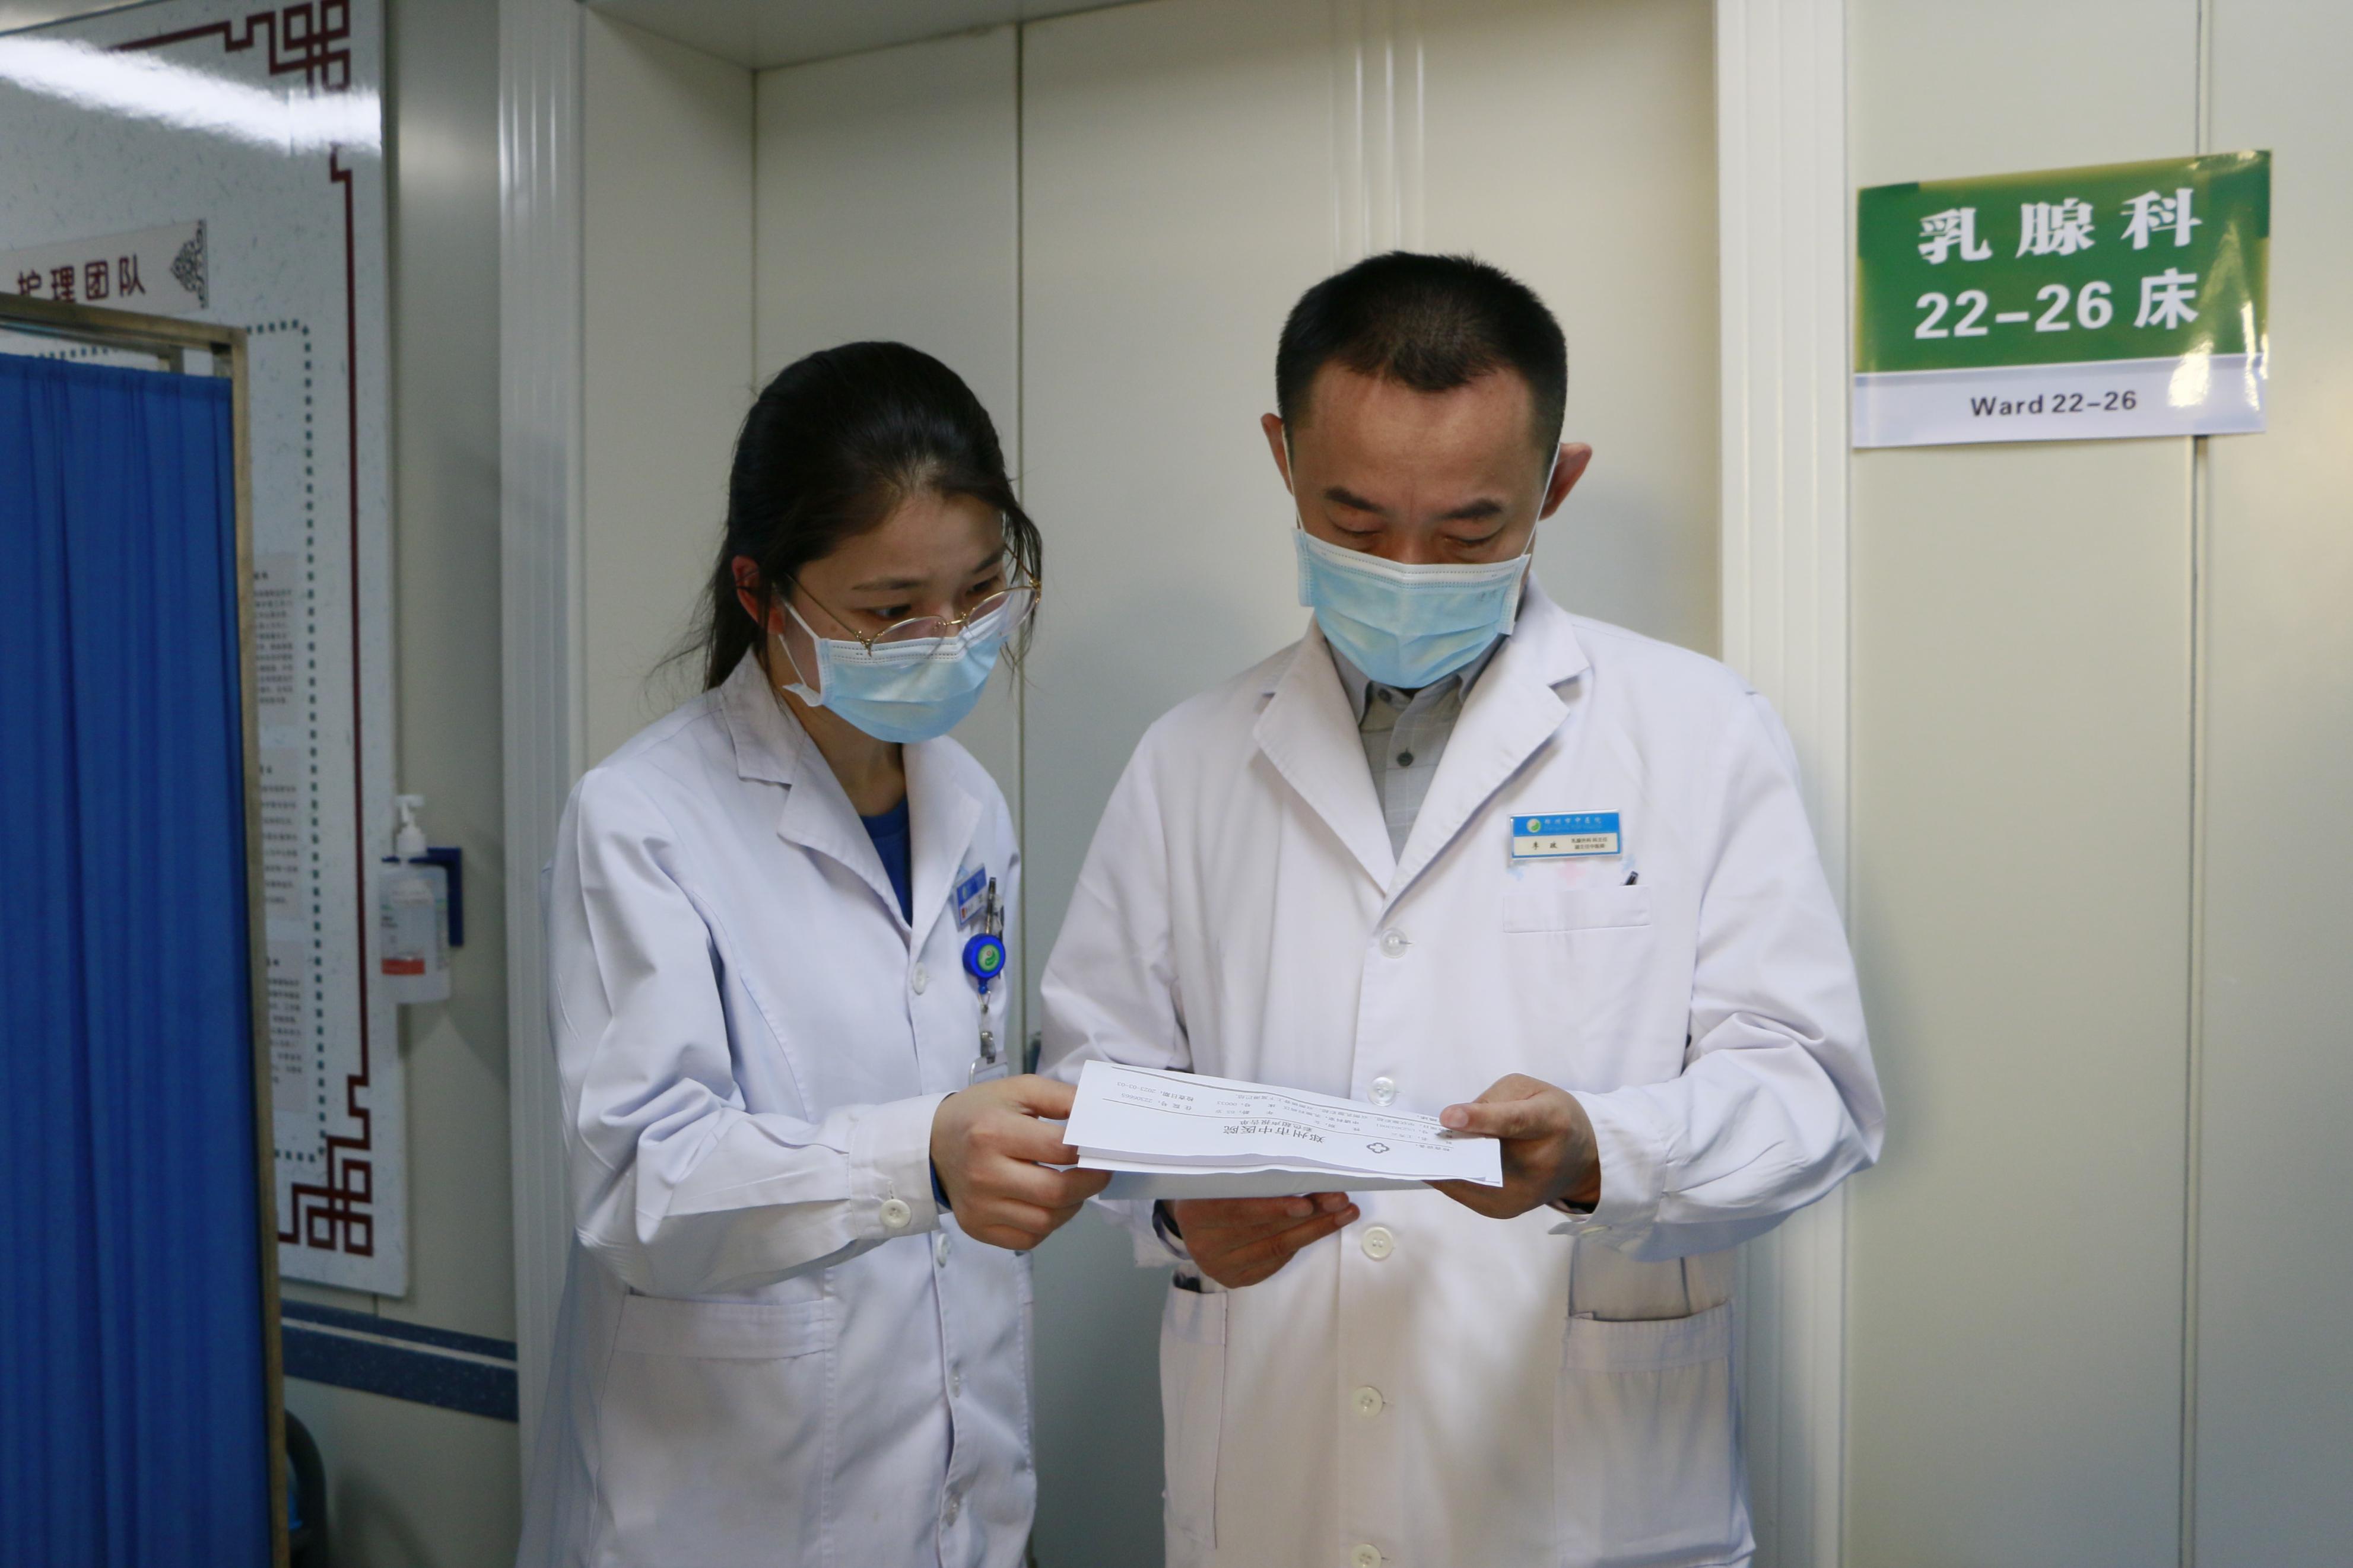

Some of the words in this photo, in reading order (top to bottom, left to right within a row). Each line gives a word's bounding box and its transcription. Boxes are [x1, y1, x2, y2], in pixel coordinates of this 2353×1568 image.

[1918, 187, 2202, 265] 乳腺科
[17, 253, 147, 303] 护理团队
[1971, 396, 2043, 417] Ward
[2052, 390, 2137, 414] 22-26
[1222, 1125, 1326, 1144] 郑州市中医院
